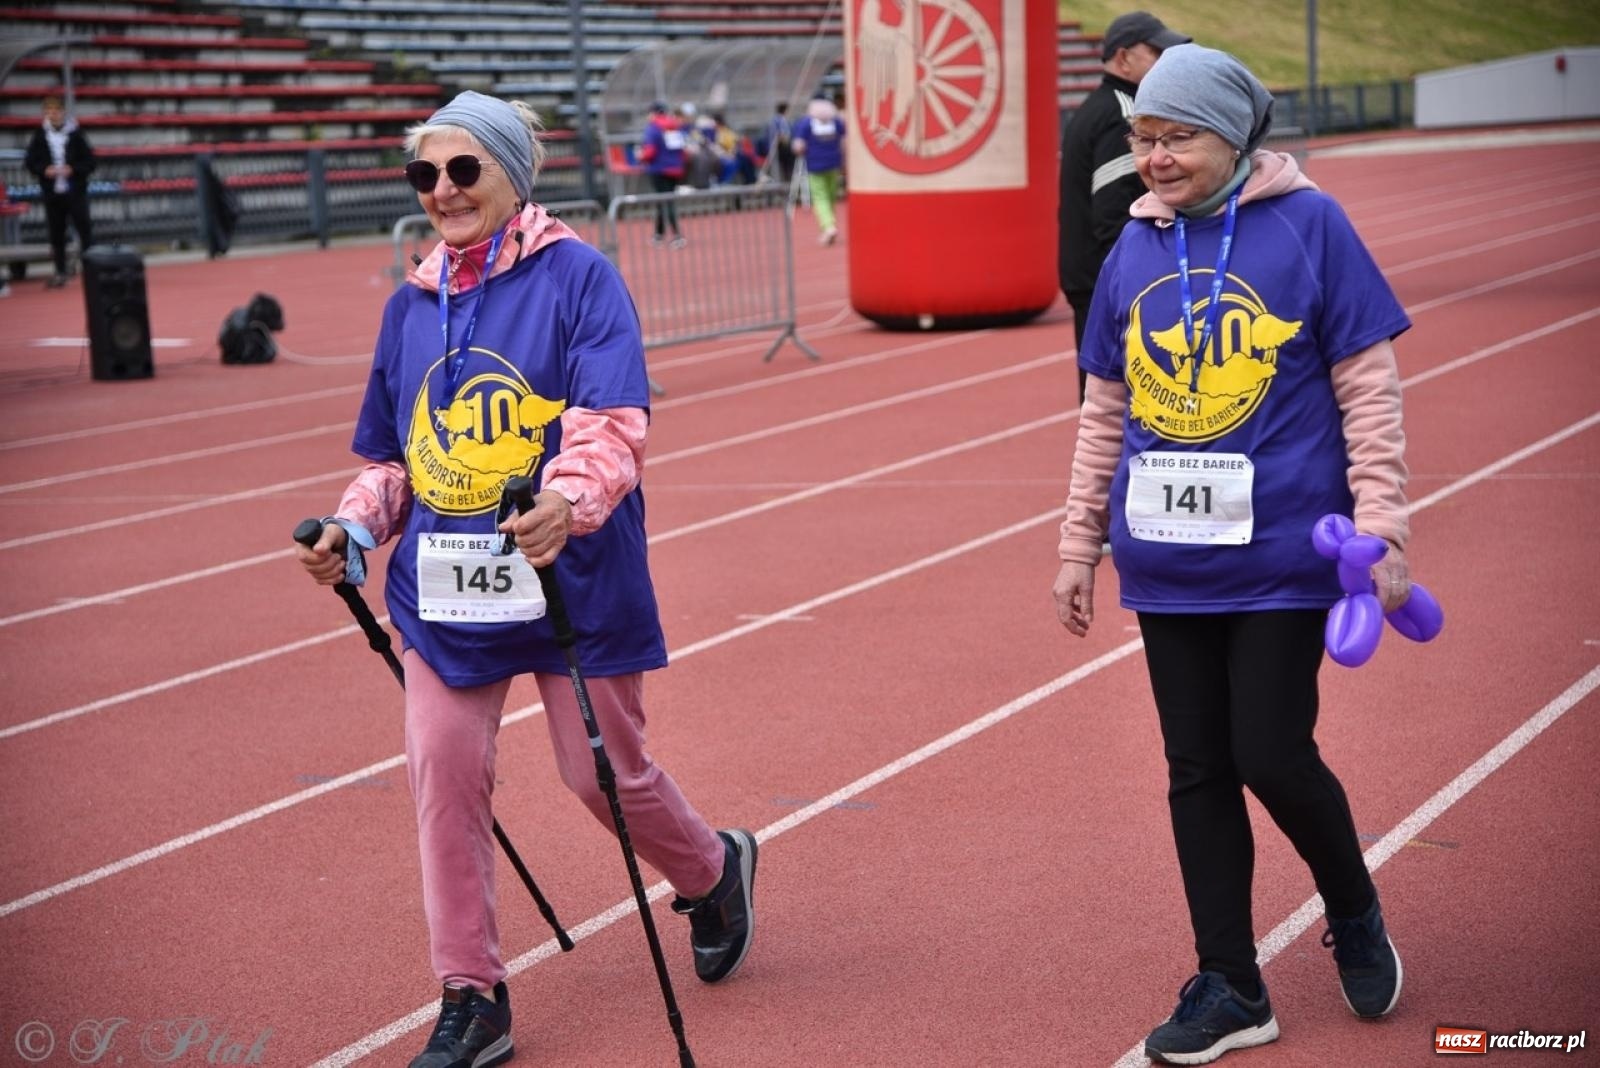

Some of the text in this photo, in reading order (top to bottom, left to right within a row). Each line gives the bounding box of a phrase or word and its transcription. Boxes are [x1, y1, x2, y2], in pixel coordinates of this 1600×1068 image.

[464, 388, 521, 444] 10
[1164, 401, 1240, 432] BIEG BEZ BARIER
[416, 434, 473, 491] RACIBORSKI
[1151, 458, 1176, 468] BIEG
[1179, 458, 1200, 469] BEZ
[1203, 459, 1245, 470] BARIER
[457, 493, 476, 506] BEZ
[1162, 484, 1212, 514] 141
[440, 539, 466, 549] BIEG
[468, 540, 490, 550] BEZ
[452, 565, 513, 593] 145
